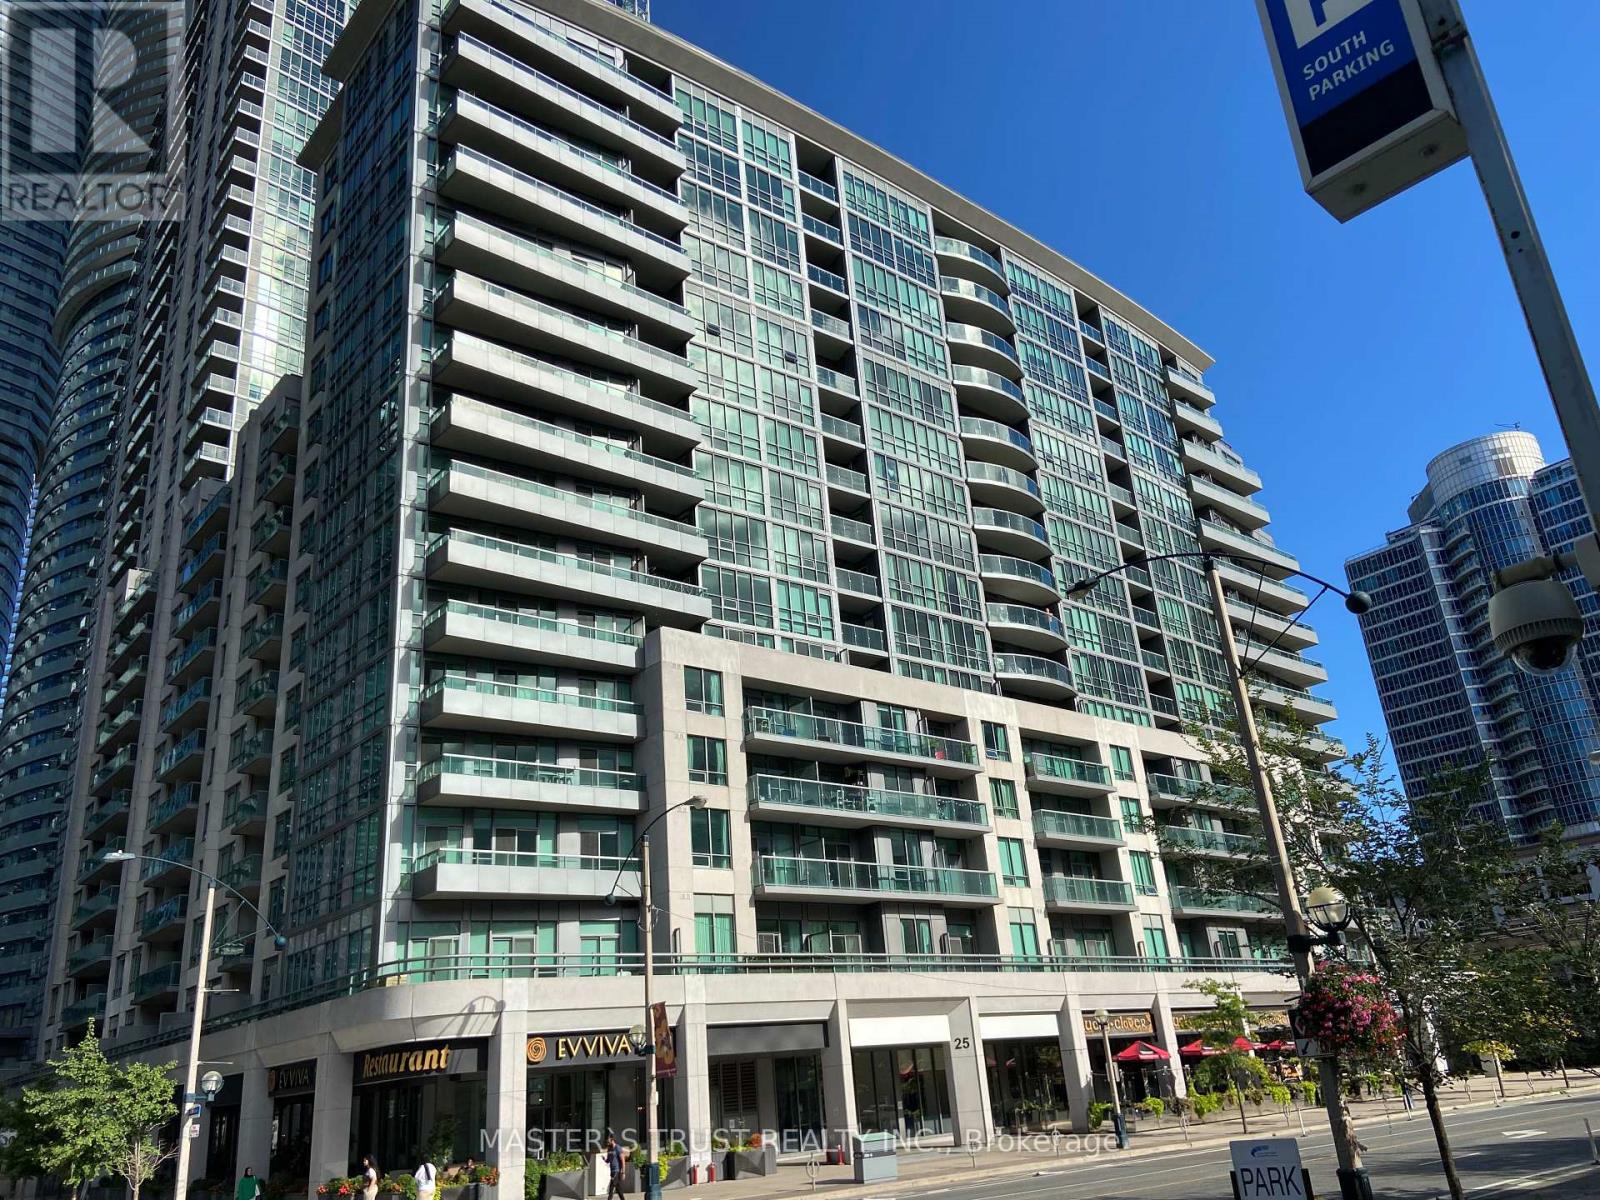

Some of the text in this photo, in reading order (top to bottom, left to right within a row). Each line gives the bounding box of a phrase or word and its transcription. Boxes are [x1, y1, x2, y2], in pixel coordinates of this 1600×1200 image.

[1303, 31, 1367, 80] SOUTH
[1308, 39, 1395, 101] PARKING
[558, 1035, 632, 1059] EVVIVA
[954, 1037, 970, 1050] 25
[362, 1043, 450, 1078] Restaurant
[1240, 1166, 1302, 1197] PARK
